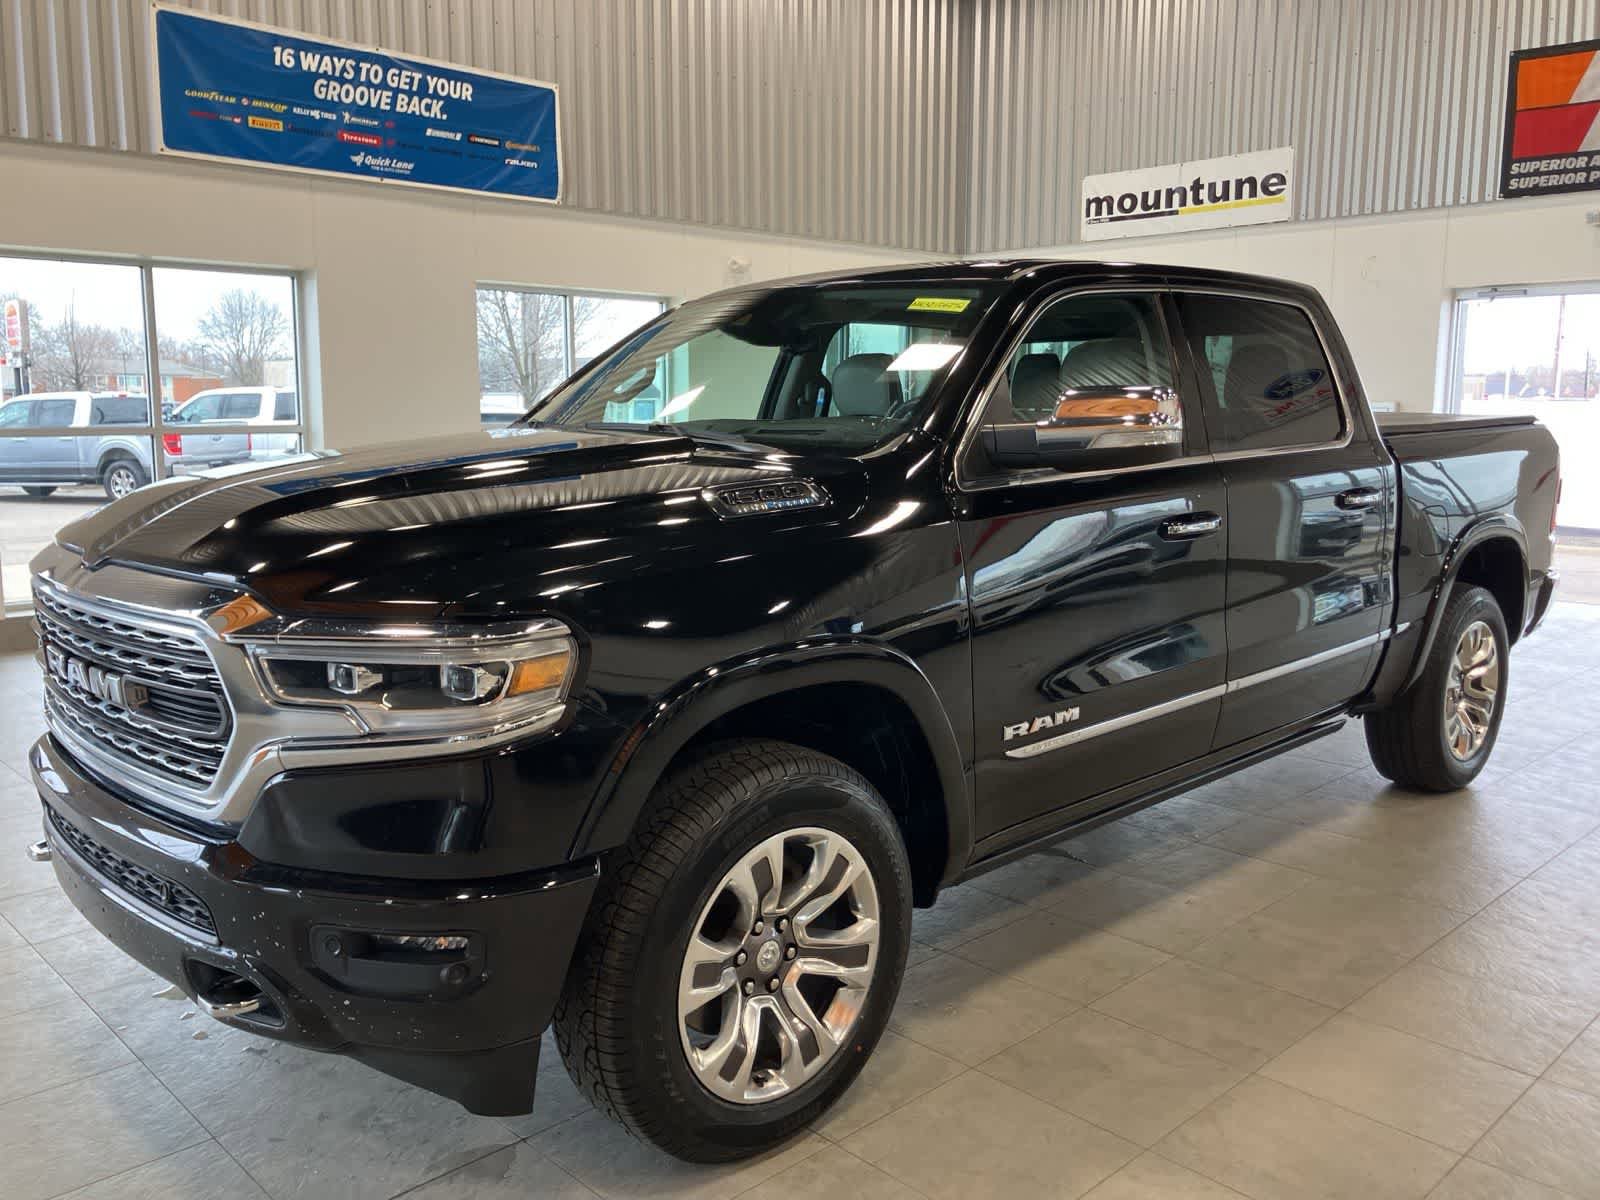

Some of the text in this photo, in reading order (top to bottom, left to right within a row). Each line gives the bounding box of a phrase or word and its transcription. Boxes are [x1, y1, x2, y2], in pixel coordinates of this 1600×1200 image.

[273, 46, 473, 101] 16 WAYS TO GET YOUR
[313, 78, 448, 121] GROOVE BACK.
[364, 155, 391, 168] Quick
[391, 159, 416, 171] Lane
[1508, 172, 1587, 190] SUPERIOR
[1510, 156, 1588, 175] SUPERIOR
[1085, 172, 1287, 218] mountune
[46, 644, 123, 707] RAM
[1003, 706, 1080, 741] RAM
